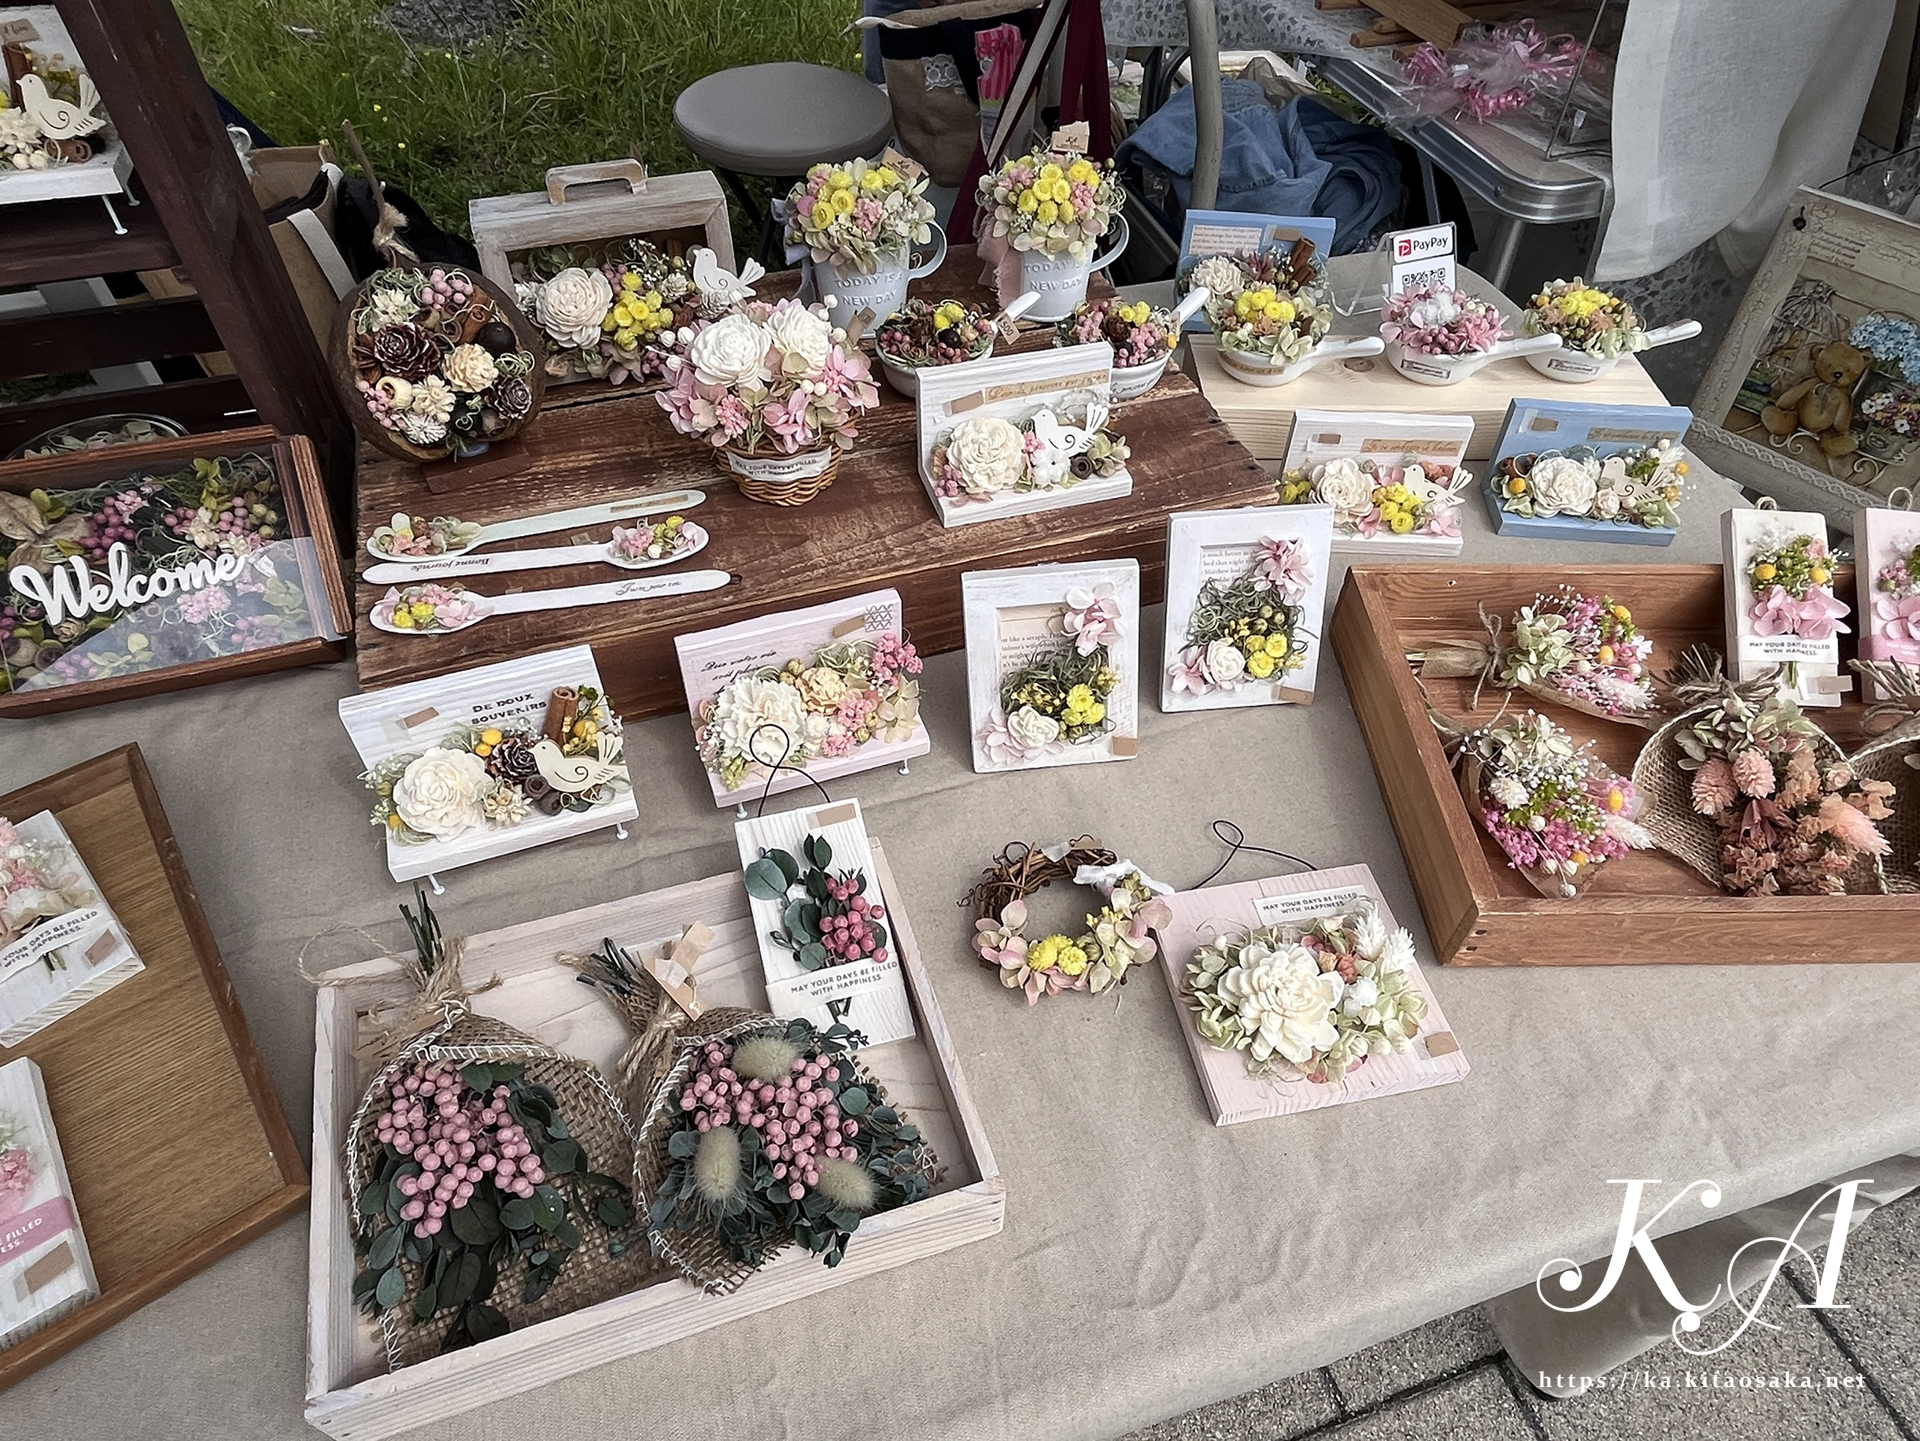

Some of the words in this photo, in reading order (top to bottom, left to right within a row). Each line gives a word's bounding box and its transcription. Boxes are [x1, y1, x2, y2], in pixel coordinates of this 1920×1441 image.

[1413, 236, 1448, 251] PayPay
[1024, 260, 1069, 274] TODAY
[834, 275, 881, 289] TODAY
[1030, 280, 1060, 291] NEW
[1062, 275, 1083, 290] DAY
[842, 295, 872, 307] NEW
[875, 289, 897, 305] DAY
[455, 558, 490, 567] Bonne
[9, 541, 250, 626] Welcome
[472, 704, 493, 713] DE
[496, 693, 534, 708] DOUX
[471, 701, 547, 725] SOUVENIRS
[1263, 903, 1279, 911] MAY
[1280, 900, 1301, 908] YOUR
[1303, 897, 1321, 905] DAYS
[1333, 892, 1358, 901] FILLED
[1281, 907, 1301, 915] WITH
[3, 946, 29, 961] YOUR
[29, 930, 51, 947] DAYS
[53, 924, 66, 933] BE
[67, 910, 98, 928] FILLED
[4, 953, 29, 968] WITH
[791, 984, 809, 994] MAY
[811, 976, 834, 988] YOUR
[836, 971, 858, 981] DAYS
[860, 968, 869, 976] BE
[871, 961, 898, 973] FILLED
[811, 986, 834, 997] WITH
[5, 1217, 43, 1242] FILLED
